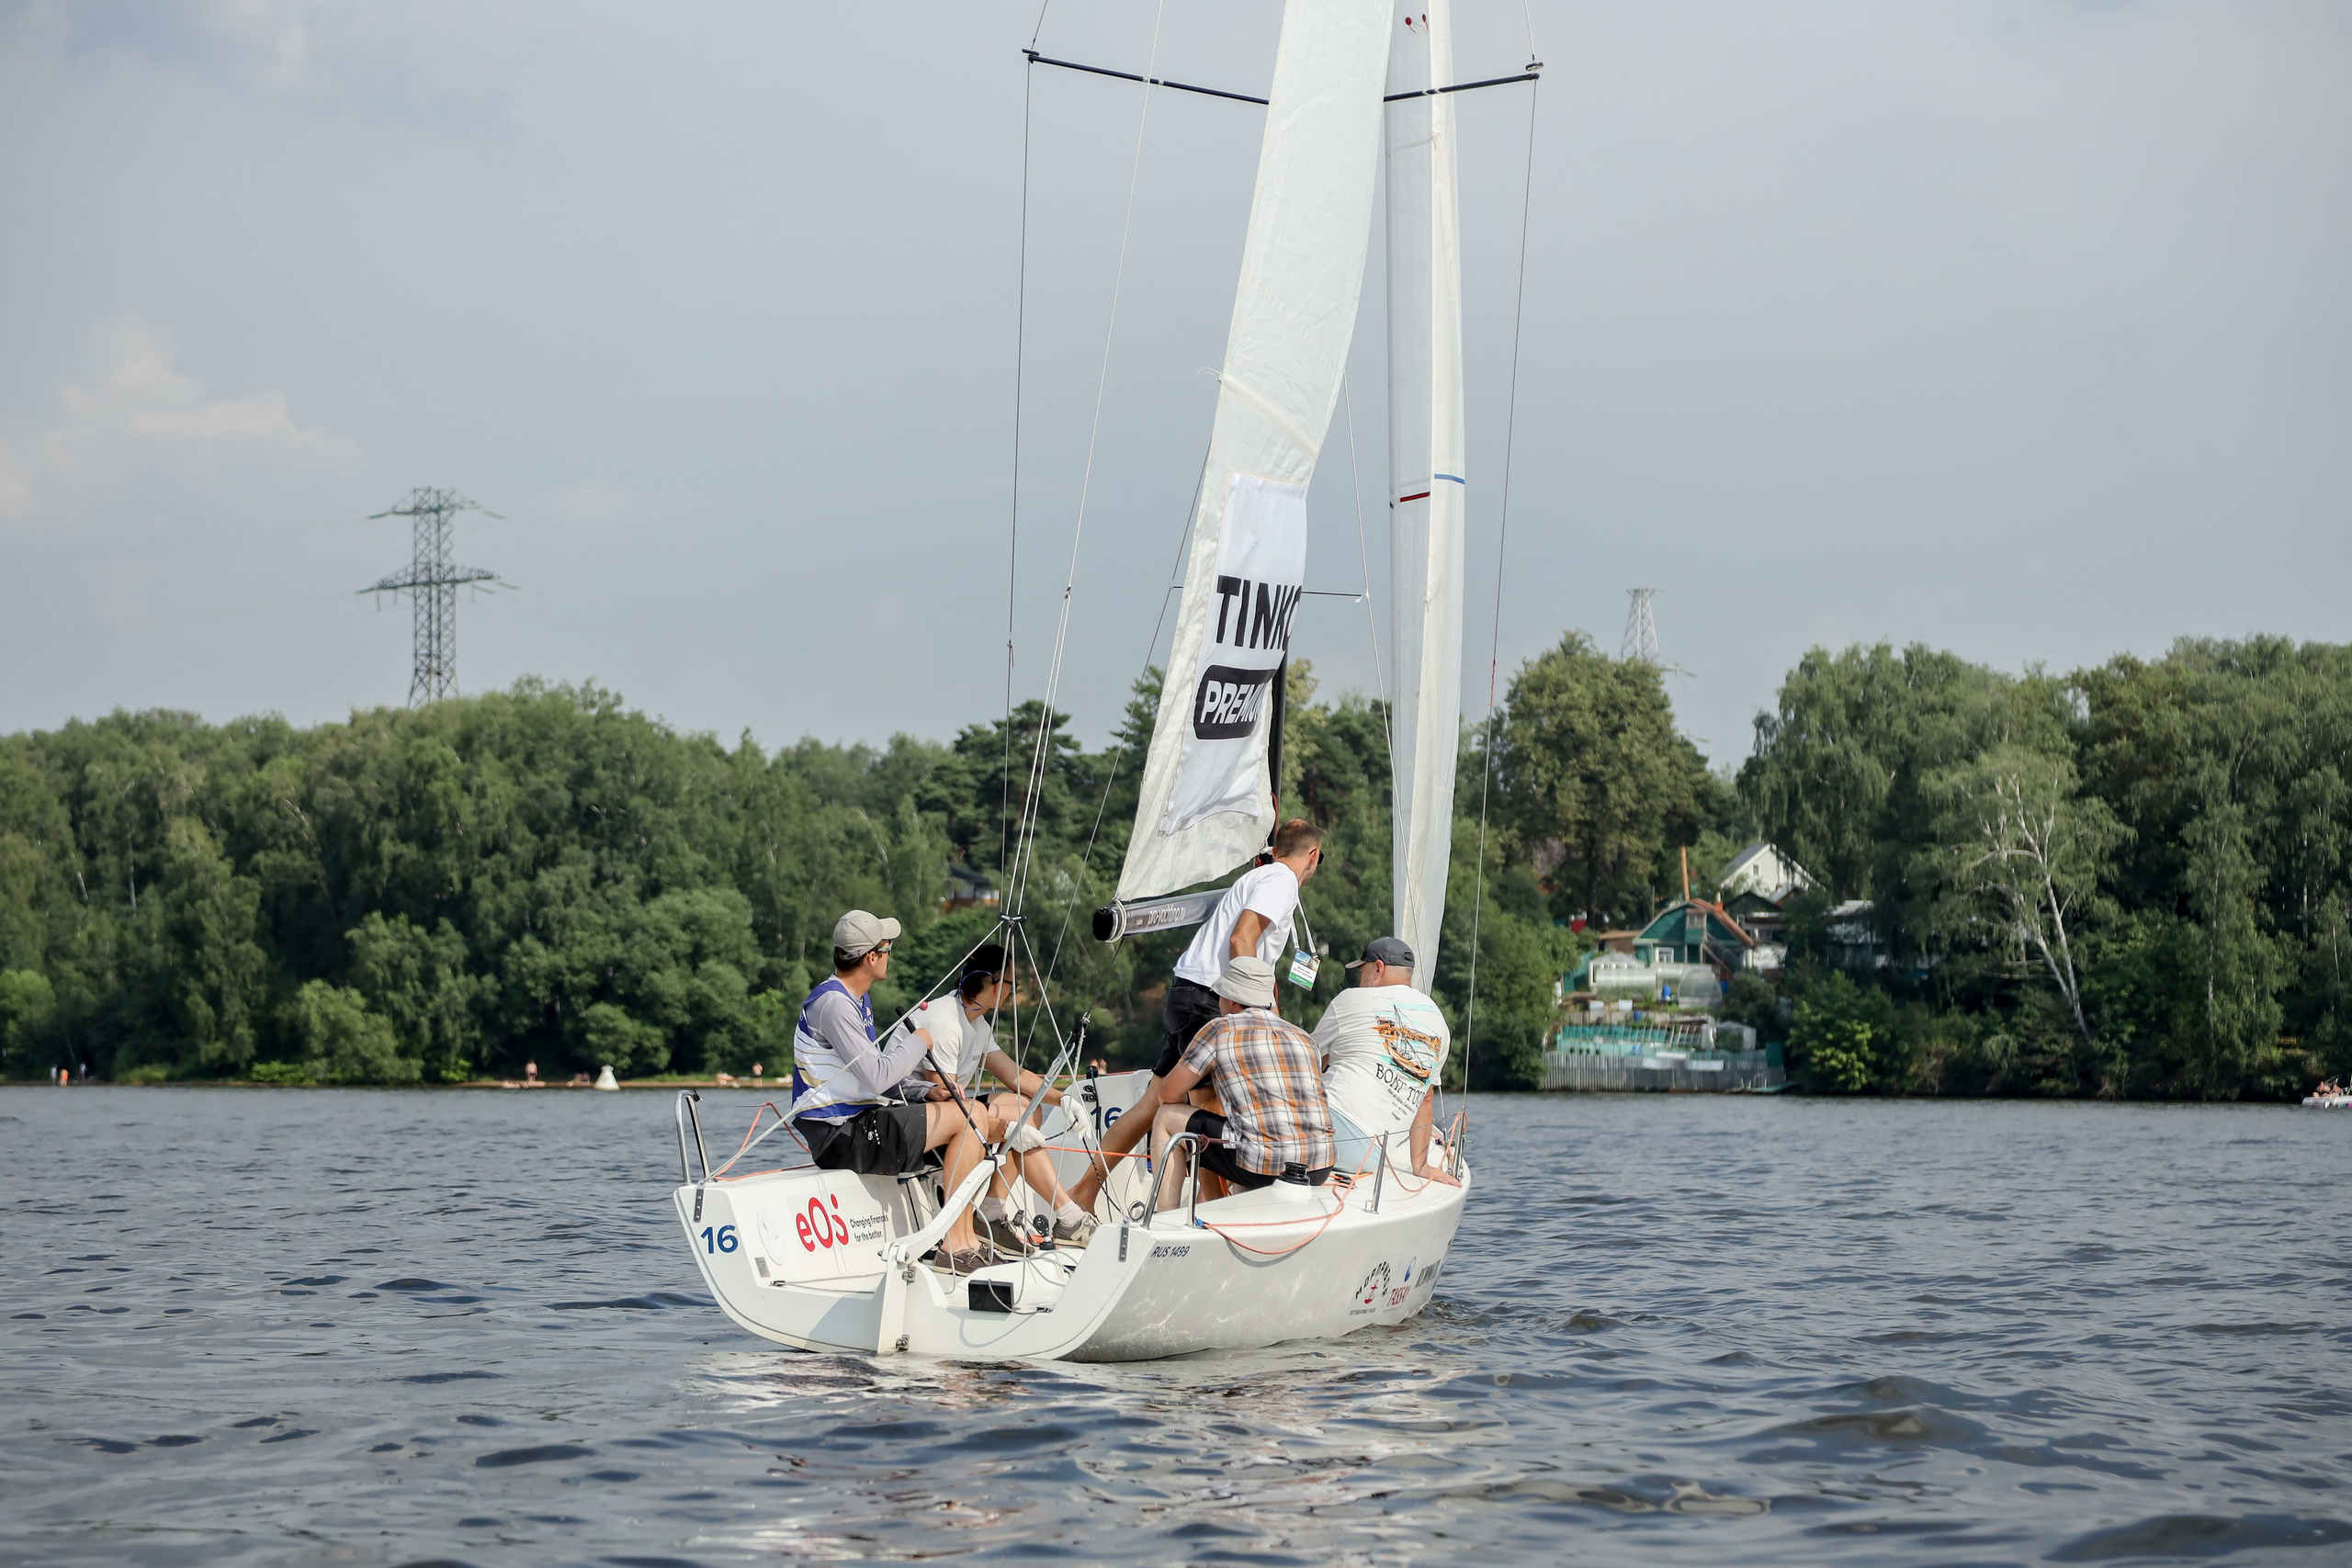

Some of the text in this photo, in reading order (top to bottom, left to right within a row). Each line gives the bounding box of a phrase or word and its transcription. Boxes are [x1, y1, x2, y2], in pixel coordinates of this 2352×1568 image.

[1375, 1062, 1408, 1094] BOAT
[1090, 1106, 1123, 1130] 16
[850, 1214, 889, 1229] Changing finances
[701, 1224, 739, 1254] 16
[854, 1233, 862, 1243] for
[861, 1232, 870, 1241] the
[1150, 1246, 1191, 1258] RUS 1499
